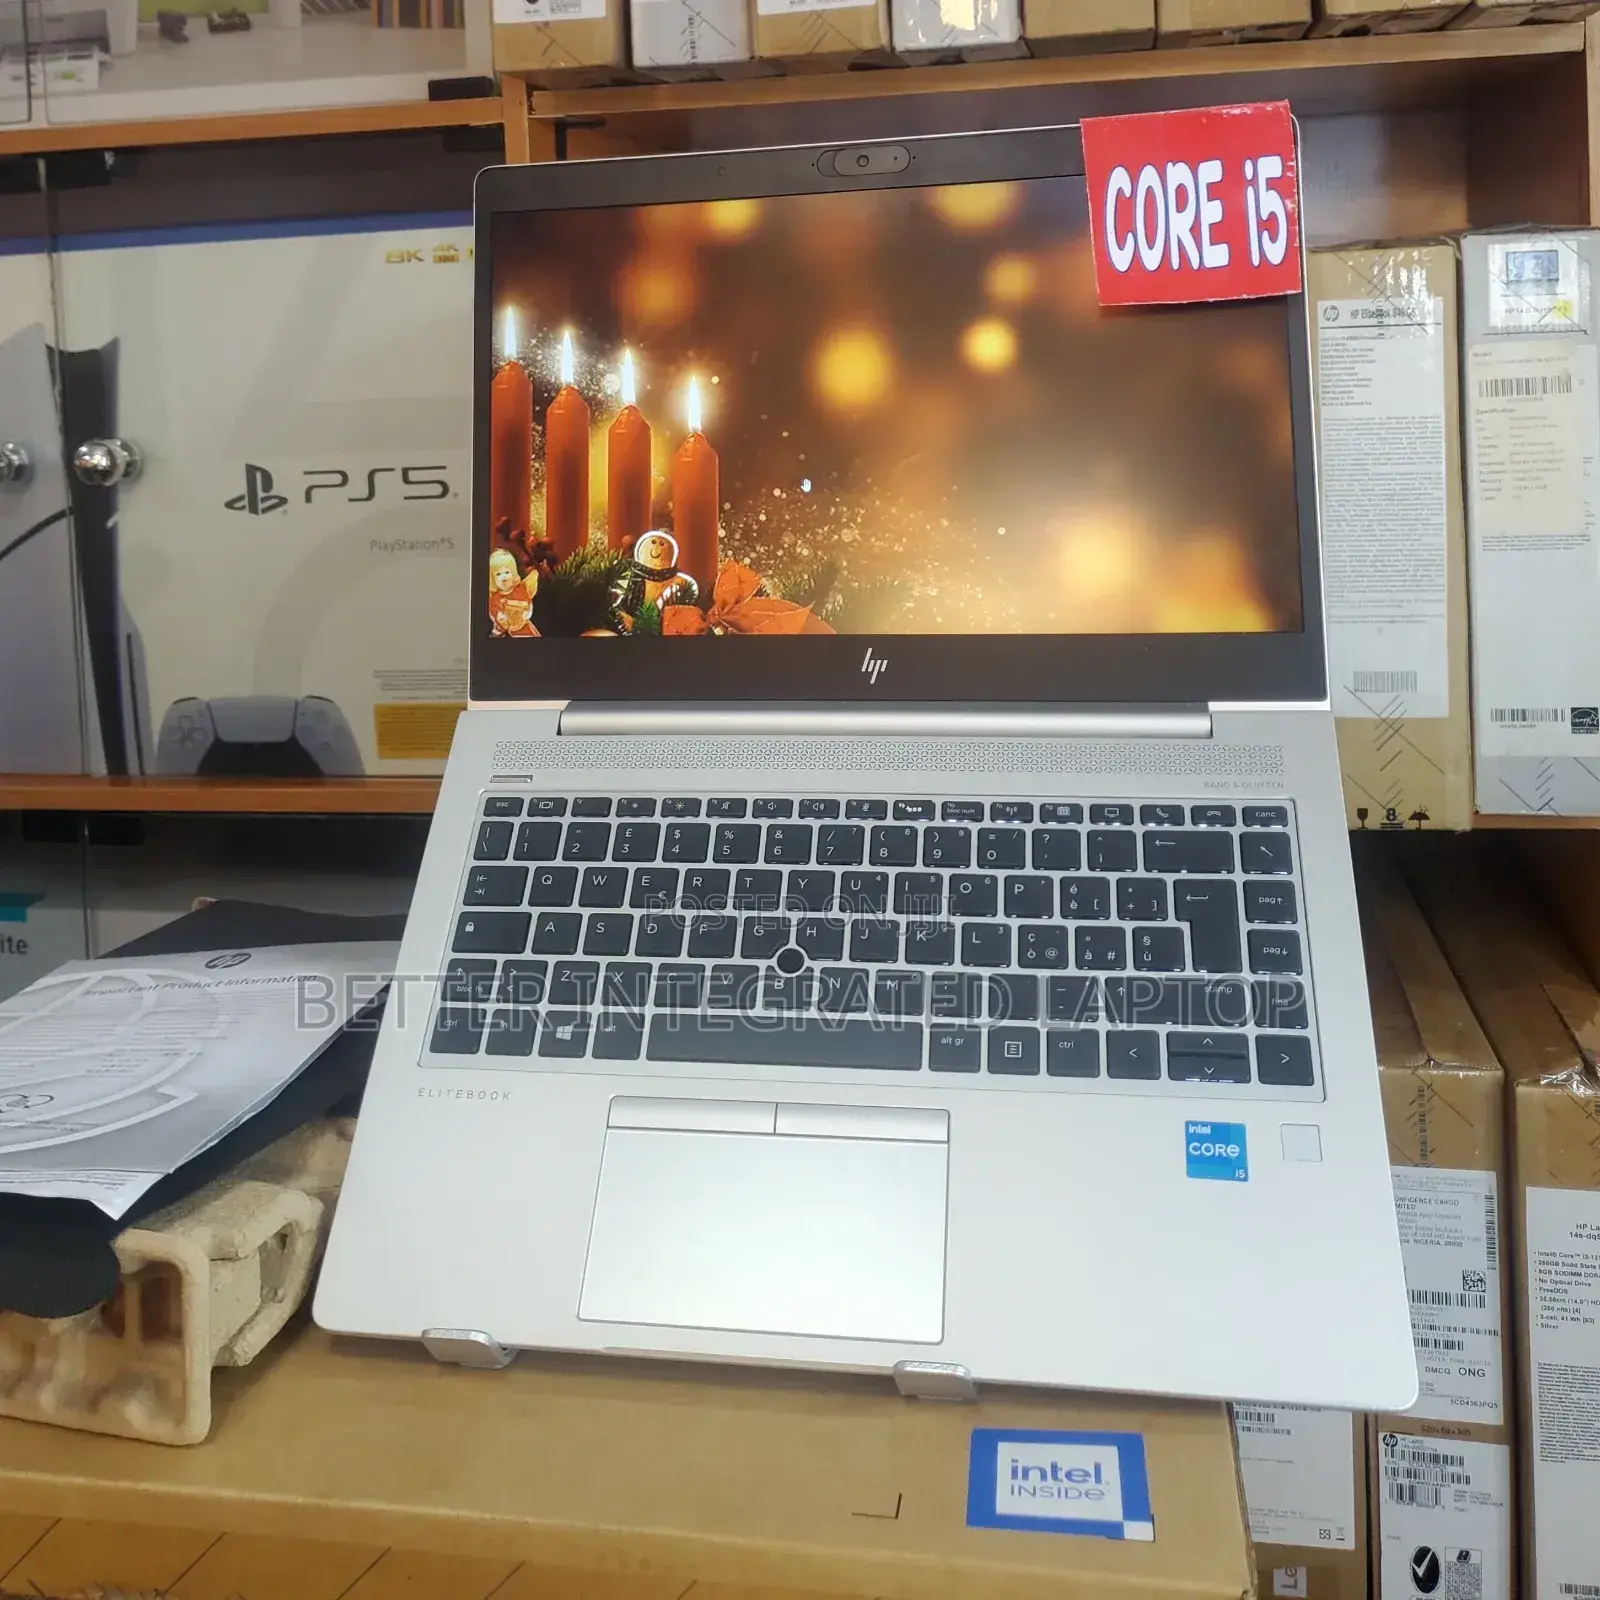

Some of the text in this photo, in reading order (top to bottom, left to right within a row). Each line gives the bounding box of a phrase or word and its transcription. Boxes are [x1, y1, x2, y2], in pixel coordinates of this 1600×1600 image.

[1105, 155, 1289, 273] CORE i5
[303, 465, 450, 504] PS5
[572, 843, 580, 852] 2
[621, 844, 629, 853] 3
[671, 844, 680, 853] 4
[723, 846, 731, 855] 5
[774, 846, 782, 855] 6
[827, 847, 834, 856] 7
[880, 848, 888, 857] 8
[933, 849, 942, 859] 9
[541, 874, 553, 886] Q
[592, 875, 607, 885] W
[641, 876, 651, 886] E
[692, 877, 702, 887] R
[744, 877, 753, 888] T
[798, 878, 808, 889] Y
[851, 880, 861, 891] U
[960, 882, 972, 893] O
[1014, 884, 1024, 895] P
[544, 921, 555, 932] A
[596, 922, 605, 933] S
[647, 924, 658, 934] D
[699, 925, 708, 935] F
[753, 925, 764, 936] G
[806, 927, 817, 937] H
[861, 928, 869, 939] J
[916, 930, 927, 941] K
[972, 932, 981, 943] L
[1045, 948, 1058, 959] @
[1107, 951, 1116, 961] #
[560, 970, 571, 982] Z
[613, 971, 624, 982] X
[667, 973, 677, 984] C
[721, 974, 733, 985] V
[83, 974, 319, 996] Important Product Information
[774, 979, 785, 990] B
[830, 977, 841, 988] N
[886, 980, 899, 991] M
[1204, 985, 1233, 994] stamp
[941, 1036, 964, 1046] alt gr
[1059, 1041, 1074, 1049] ctrl
[417, 1088, 511, 1100] ELITEBOOK
[1188, 1124, 1211, 1134] intel
[1395, 1196, 1432, 1205] ONFIDENCE
[1576, 1223, 1600, 1232] HP La
[1540, 1322, 1559, 1330] Silver
[1458, 1367, 1486, 1378] ONG
[1010, 1458, 1103, 1485] intel
